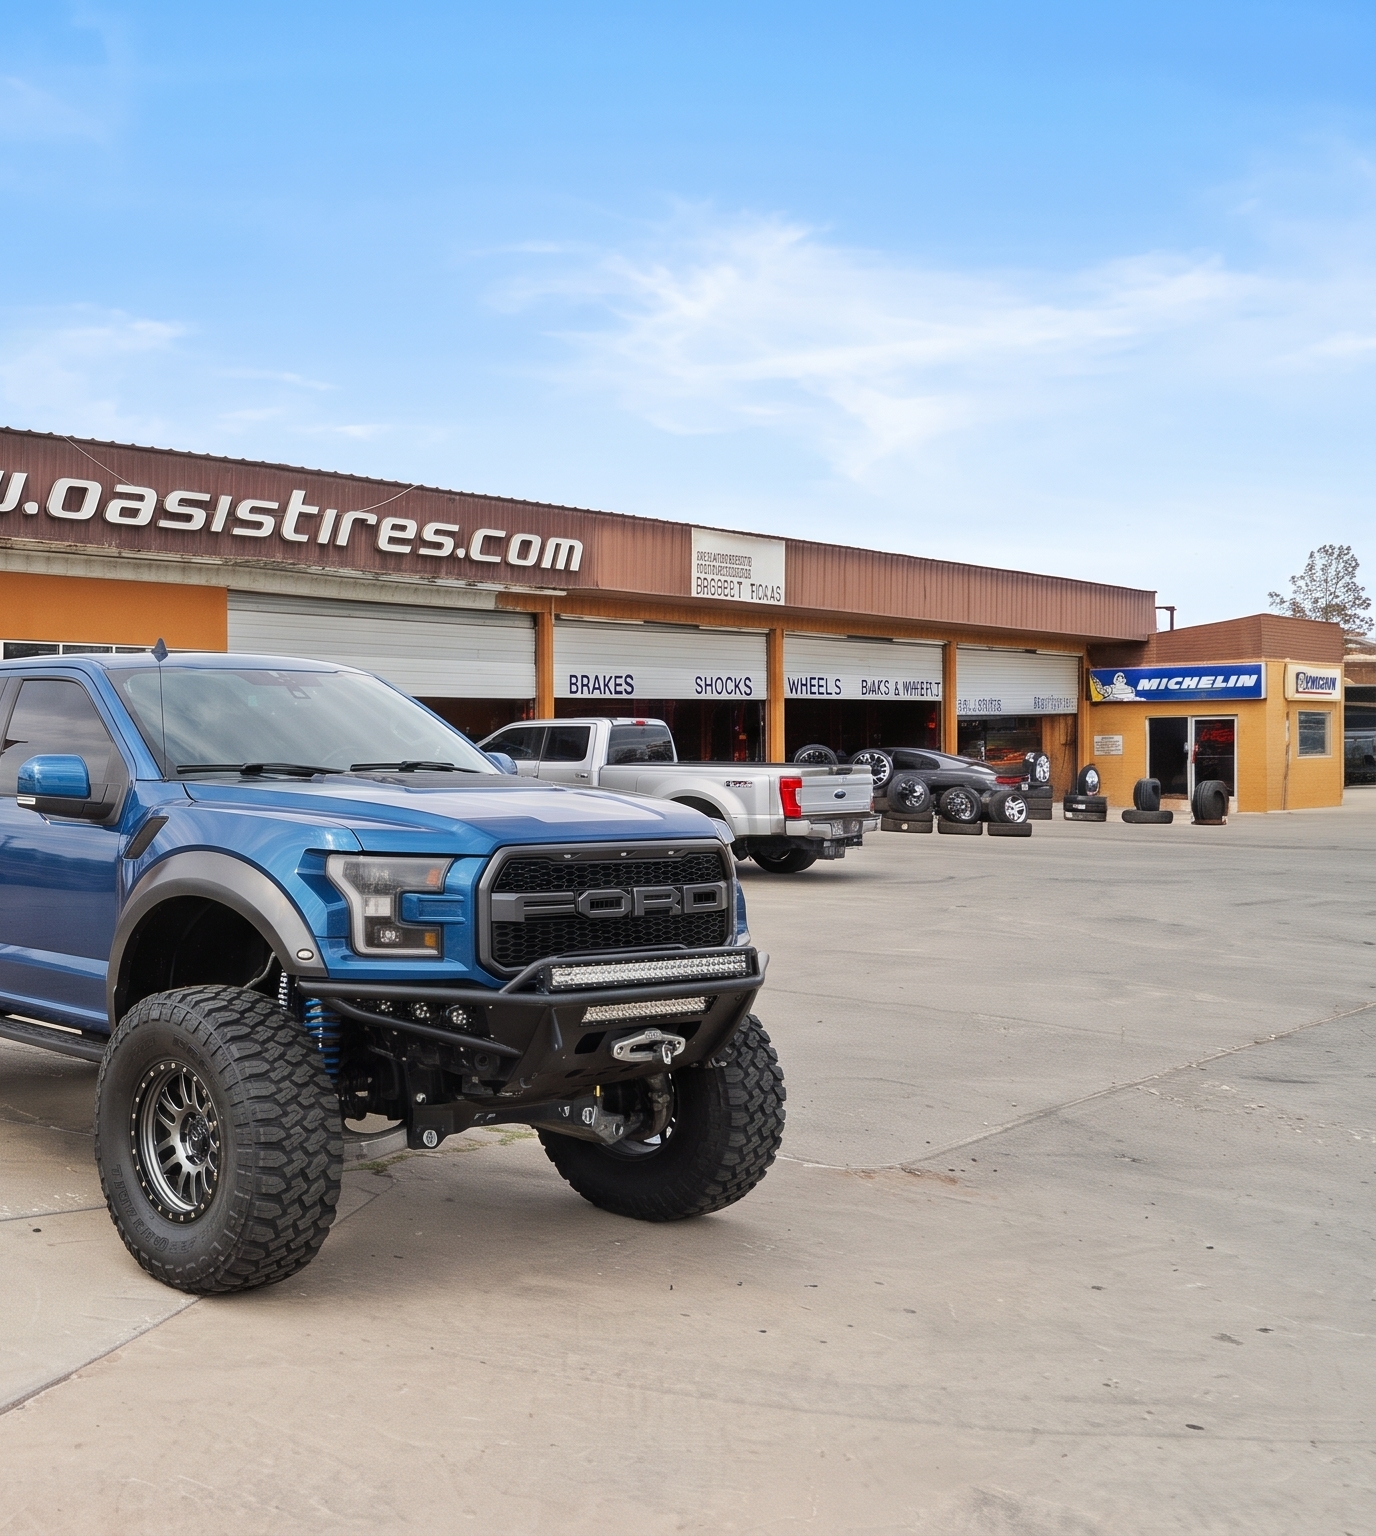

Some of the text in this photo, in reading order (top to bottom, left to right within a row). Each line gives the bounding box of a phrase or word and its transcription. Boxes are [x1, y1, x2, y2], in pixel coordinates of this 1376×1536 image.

[569, 674, 753, 696] BRAKES SHOCKS
[787, 677, 842, 695] WHEELS
[1136, 674, 1258, 691] MICHELIN
